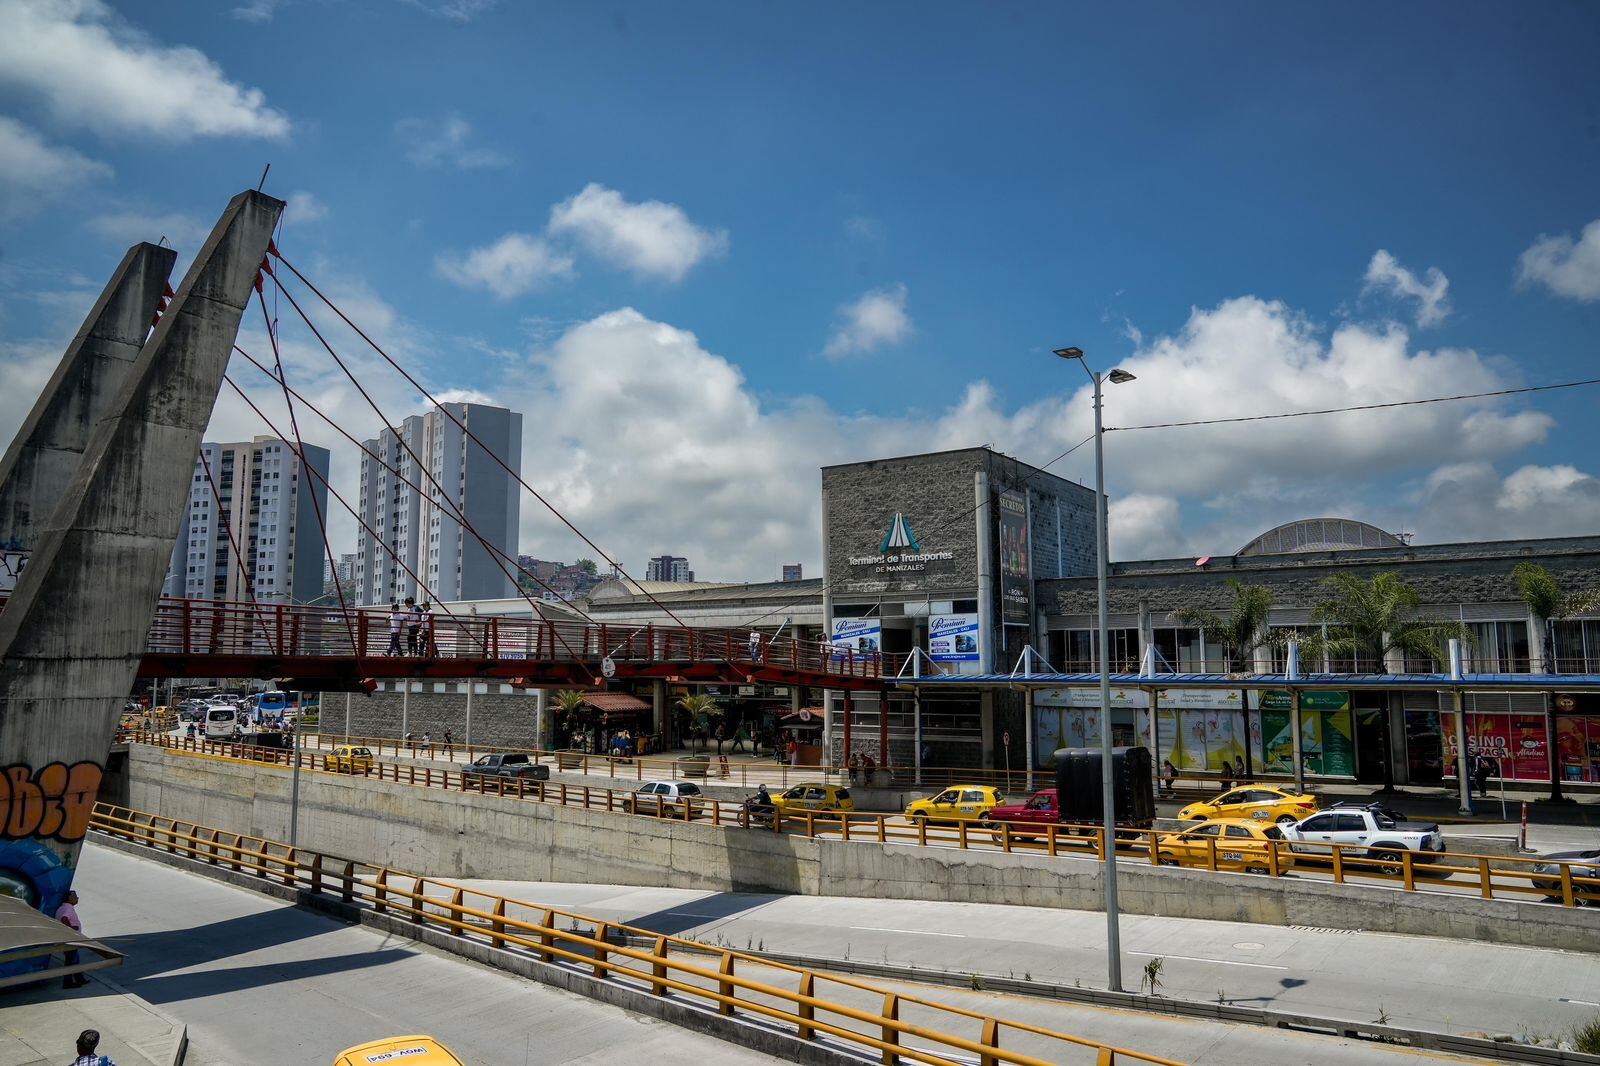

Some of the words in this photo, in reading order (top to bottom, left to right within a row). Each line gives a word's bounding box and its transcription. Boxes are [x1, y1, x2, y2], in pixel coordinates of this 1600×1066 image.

[1000, 497, 1025, 513] SECRETOS
[848, 555, 885, 566] Terminal
[887, 555, 899, 564] de
[900, 551, 953, 563] Transportes
[886, 563, 925, 572] MANIZALES
[835, 620, 867, 633] Premium
[932, 617, 966, 632] Premium
[1448, 735, 1506, 748] CSINO
[1451, 746, 1475, 758] MS
